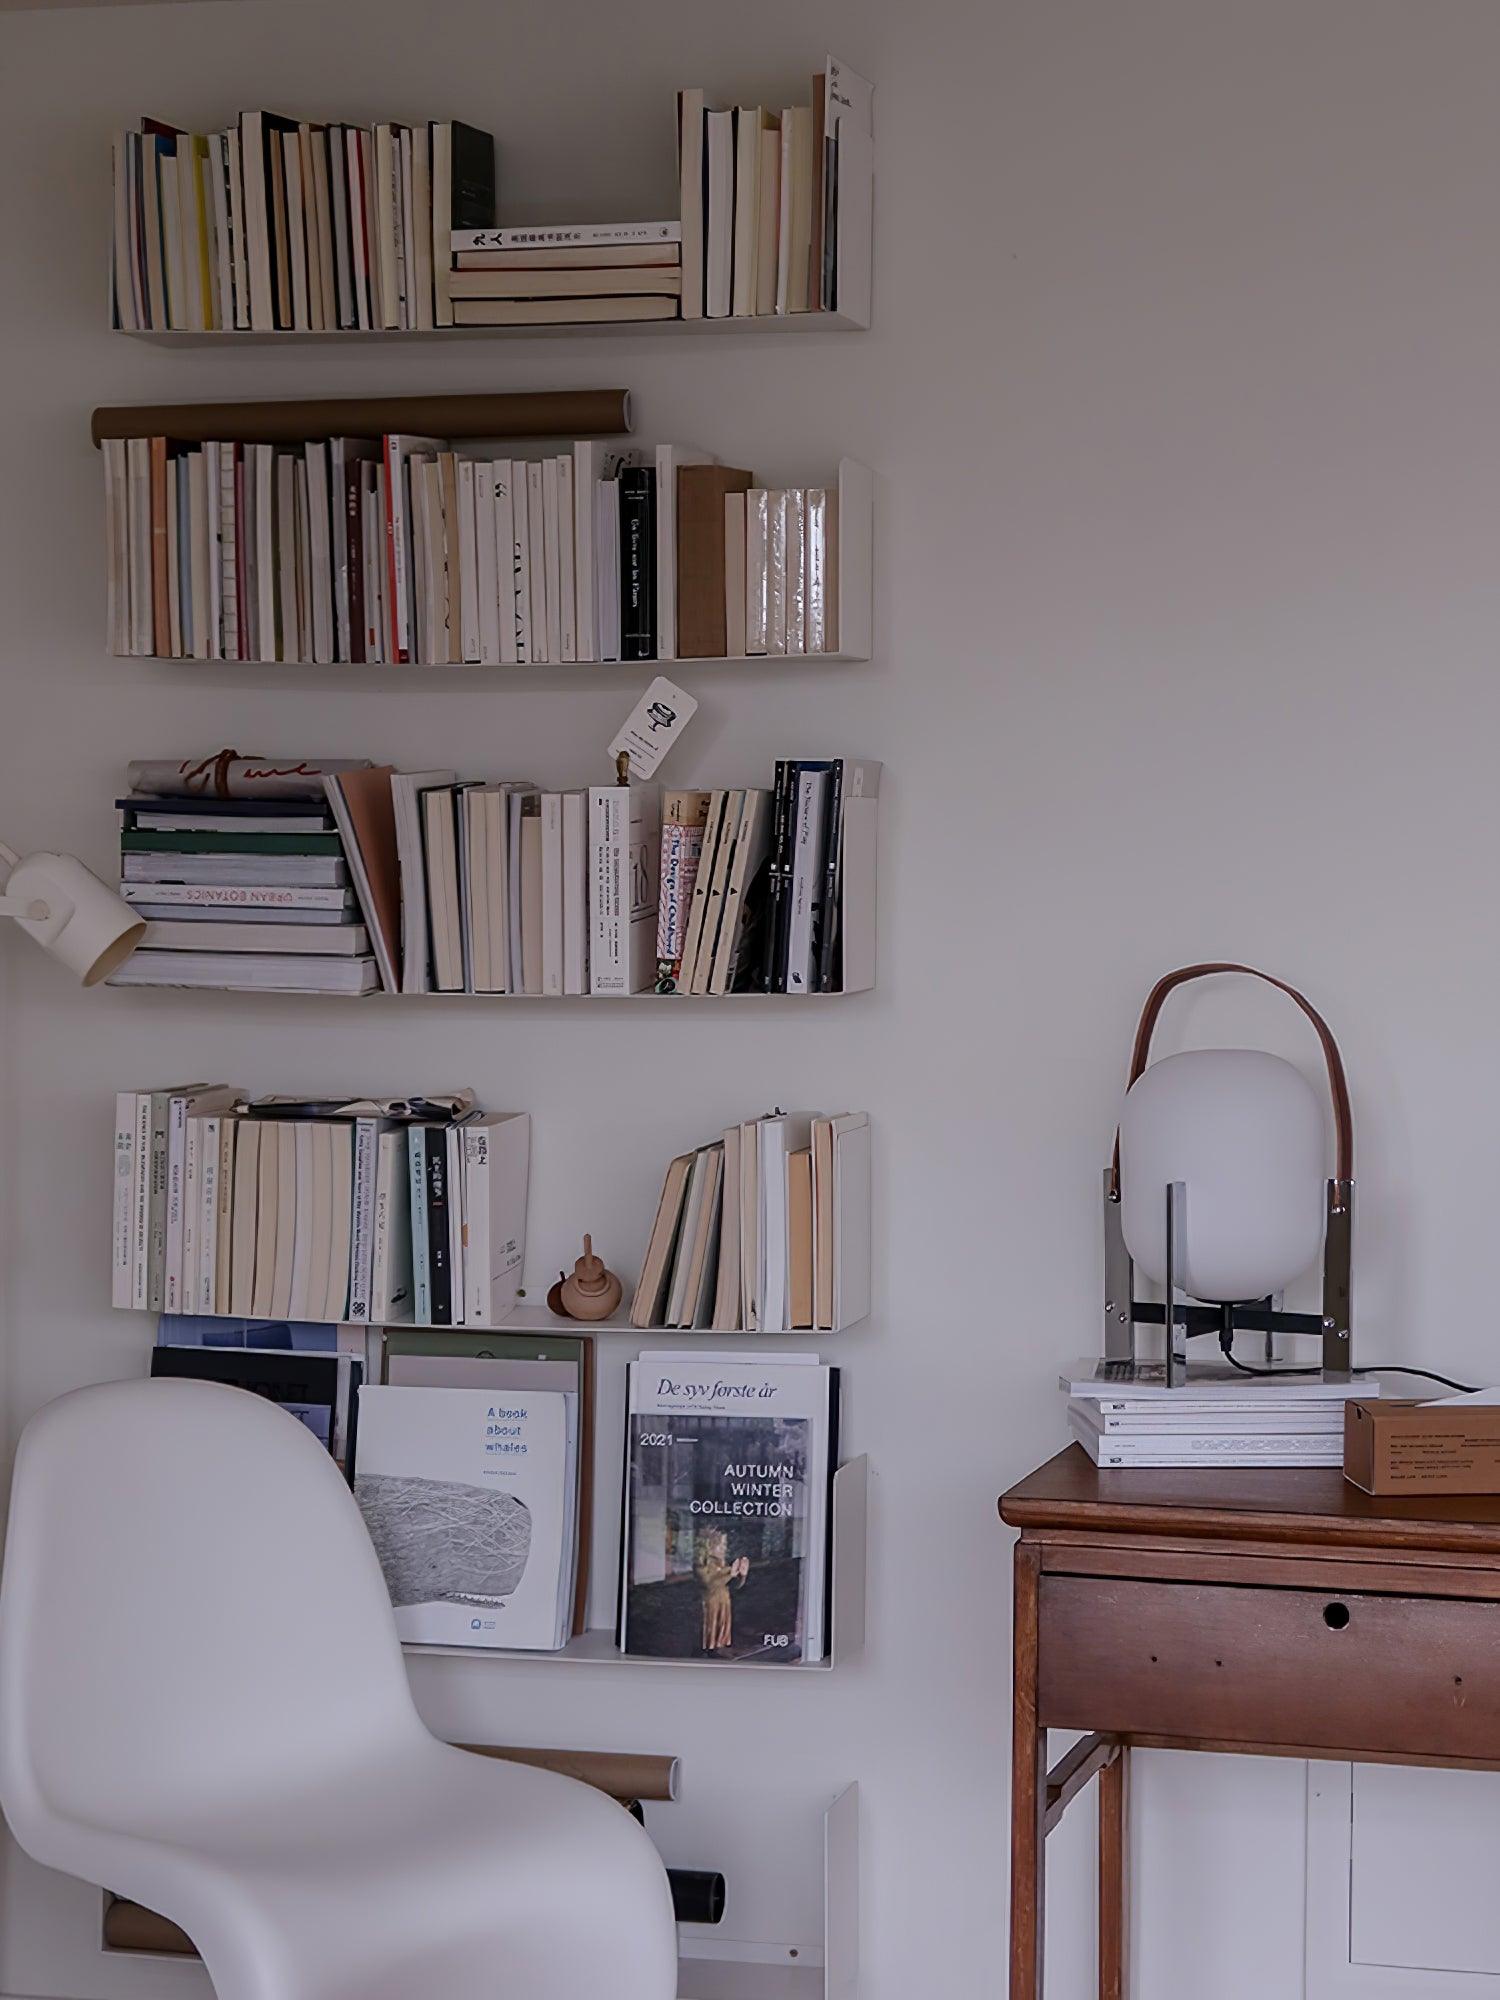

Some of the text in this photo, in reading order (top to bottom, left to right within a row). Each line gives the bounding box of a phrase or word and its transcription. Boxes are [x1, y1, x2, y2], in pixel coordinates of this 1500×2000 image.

[666, 859, 679, 890] Design
[185, 888, 248, 903] BOTANICS
[250, 890, 294, 904] URBAN
[665, 905, 678, 955] Childhood
[657, 1377, 778, 1401] De syv første år
[487, 1407, 528, 1419] A book
[486, 1424, 521, 1435] about
[485, 1442, 528, 1453] whales
[640, 1433, 673, 1447] 2021
[724, 1463, 794, 1479] AUTUMN
[731, 1482, 793, 1498] WINTER
[689, 1499, 793, 1517] COLLECTION
